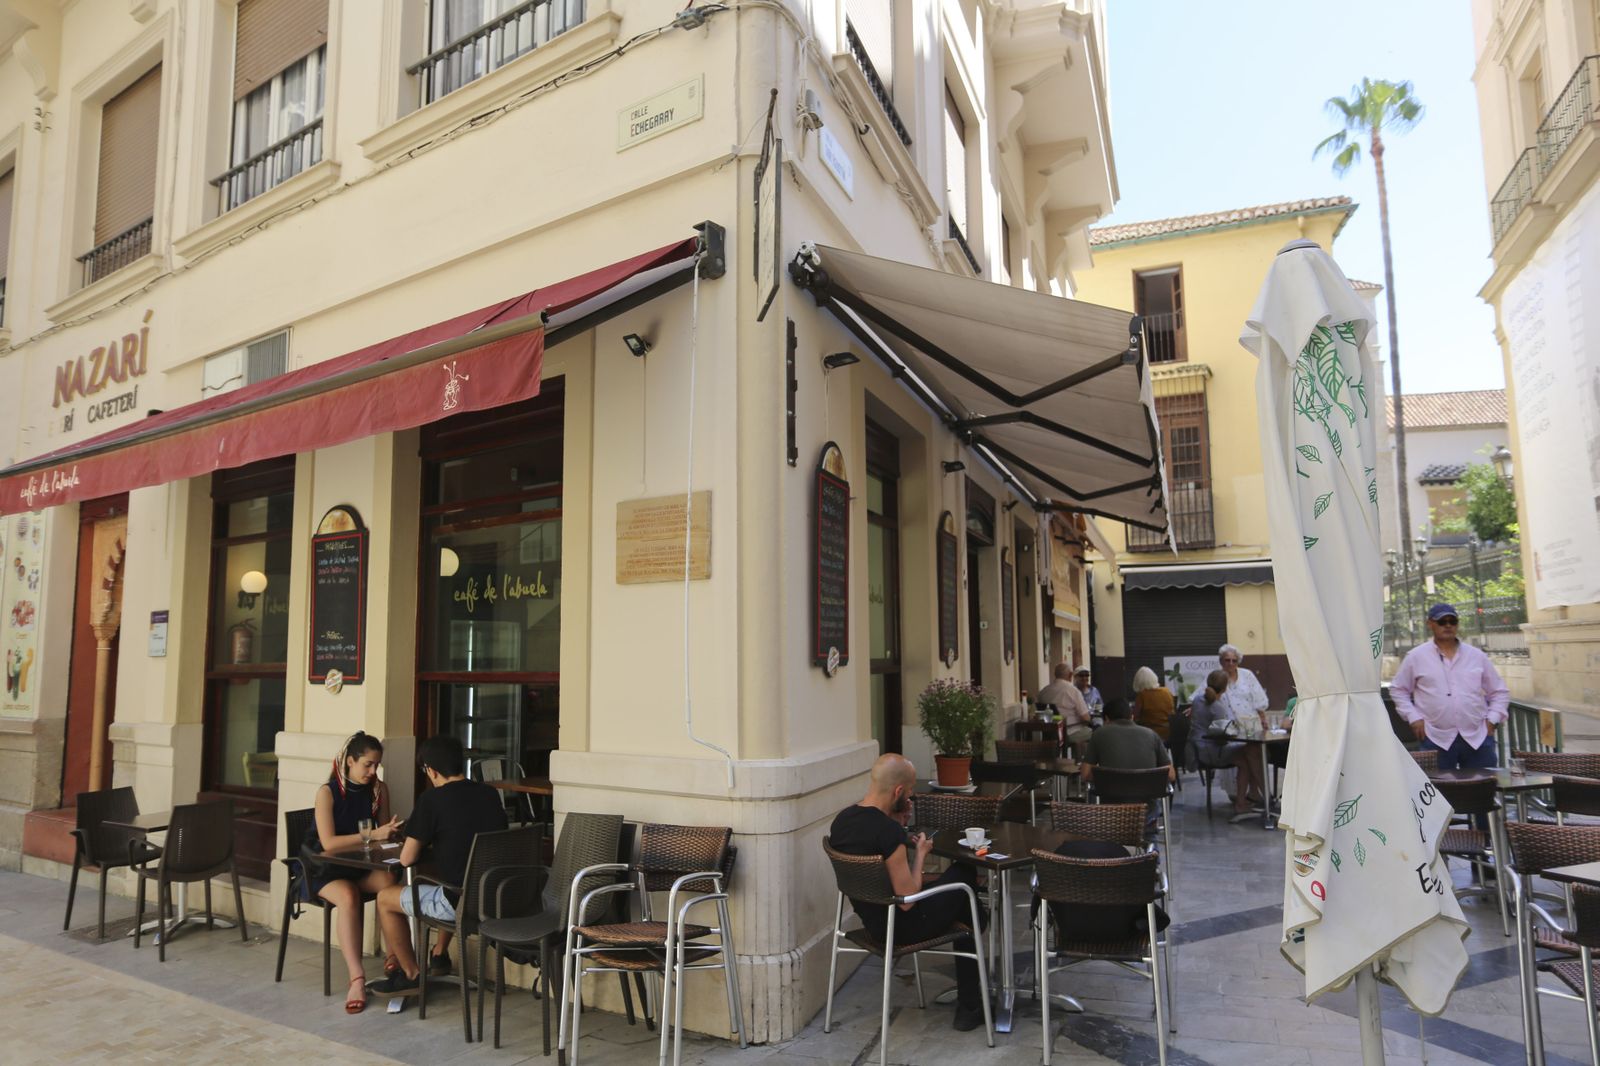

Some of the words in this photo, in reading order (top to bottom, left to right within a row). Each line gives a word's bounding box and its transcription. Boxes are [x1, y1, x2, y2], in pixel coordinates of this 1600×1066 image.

[630, 105, 648, 120] CALLE
[630, 107, 675, 137] ECHEGARAY
[52, 309, 154, 408] NAZARÍ
[87, 384, 138, 423] CAFETERÍ
[39, 472, 49, 496] de
[454, 577, 479, 613] café
[483, 574, 498, 604] de
[502, 570, 548, 600] l'abuela
